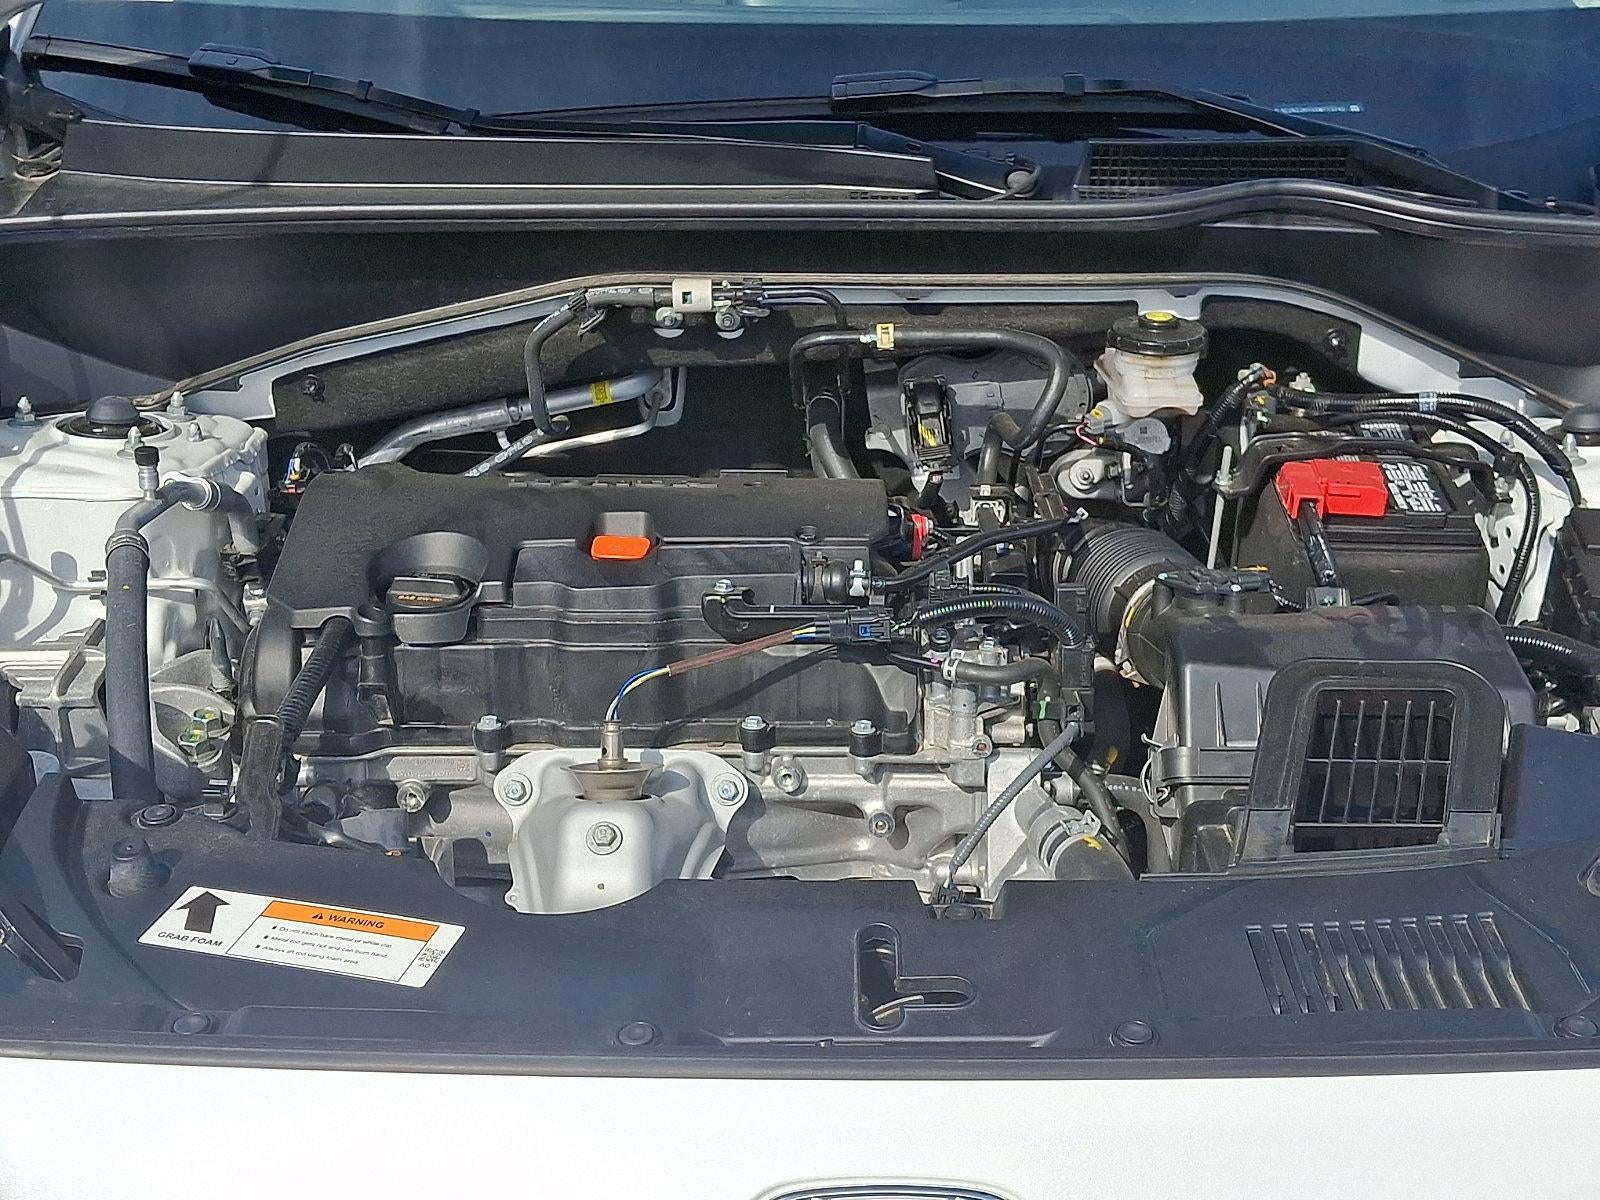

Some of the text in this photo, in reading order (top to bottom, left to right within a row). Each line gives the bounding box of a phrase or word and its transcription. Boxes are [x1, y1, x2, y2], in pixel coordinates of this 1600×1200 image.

[328, 913, 385, 929] WARNING
[157, 931, 224, 948] GRAB FOAM
[262, 945, 285, 953] Always
